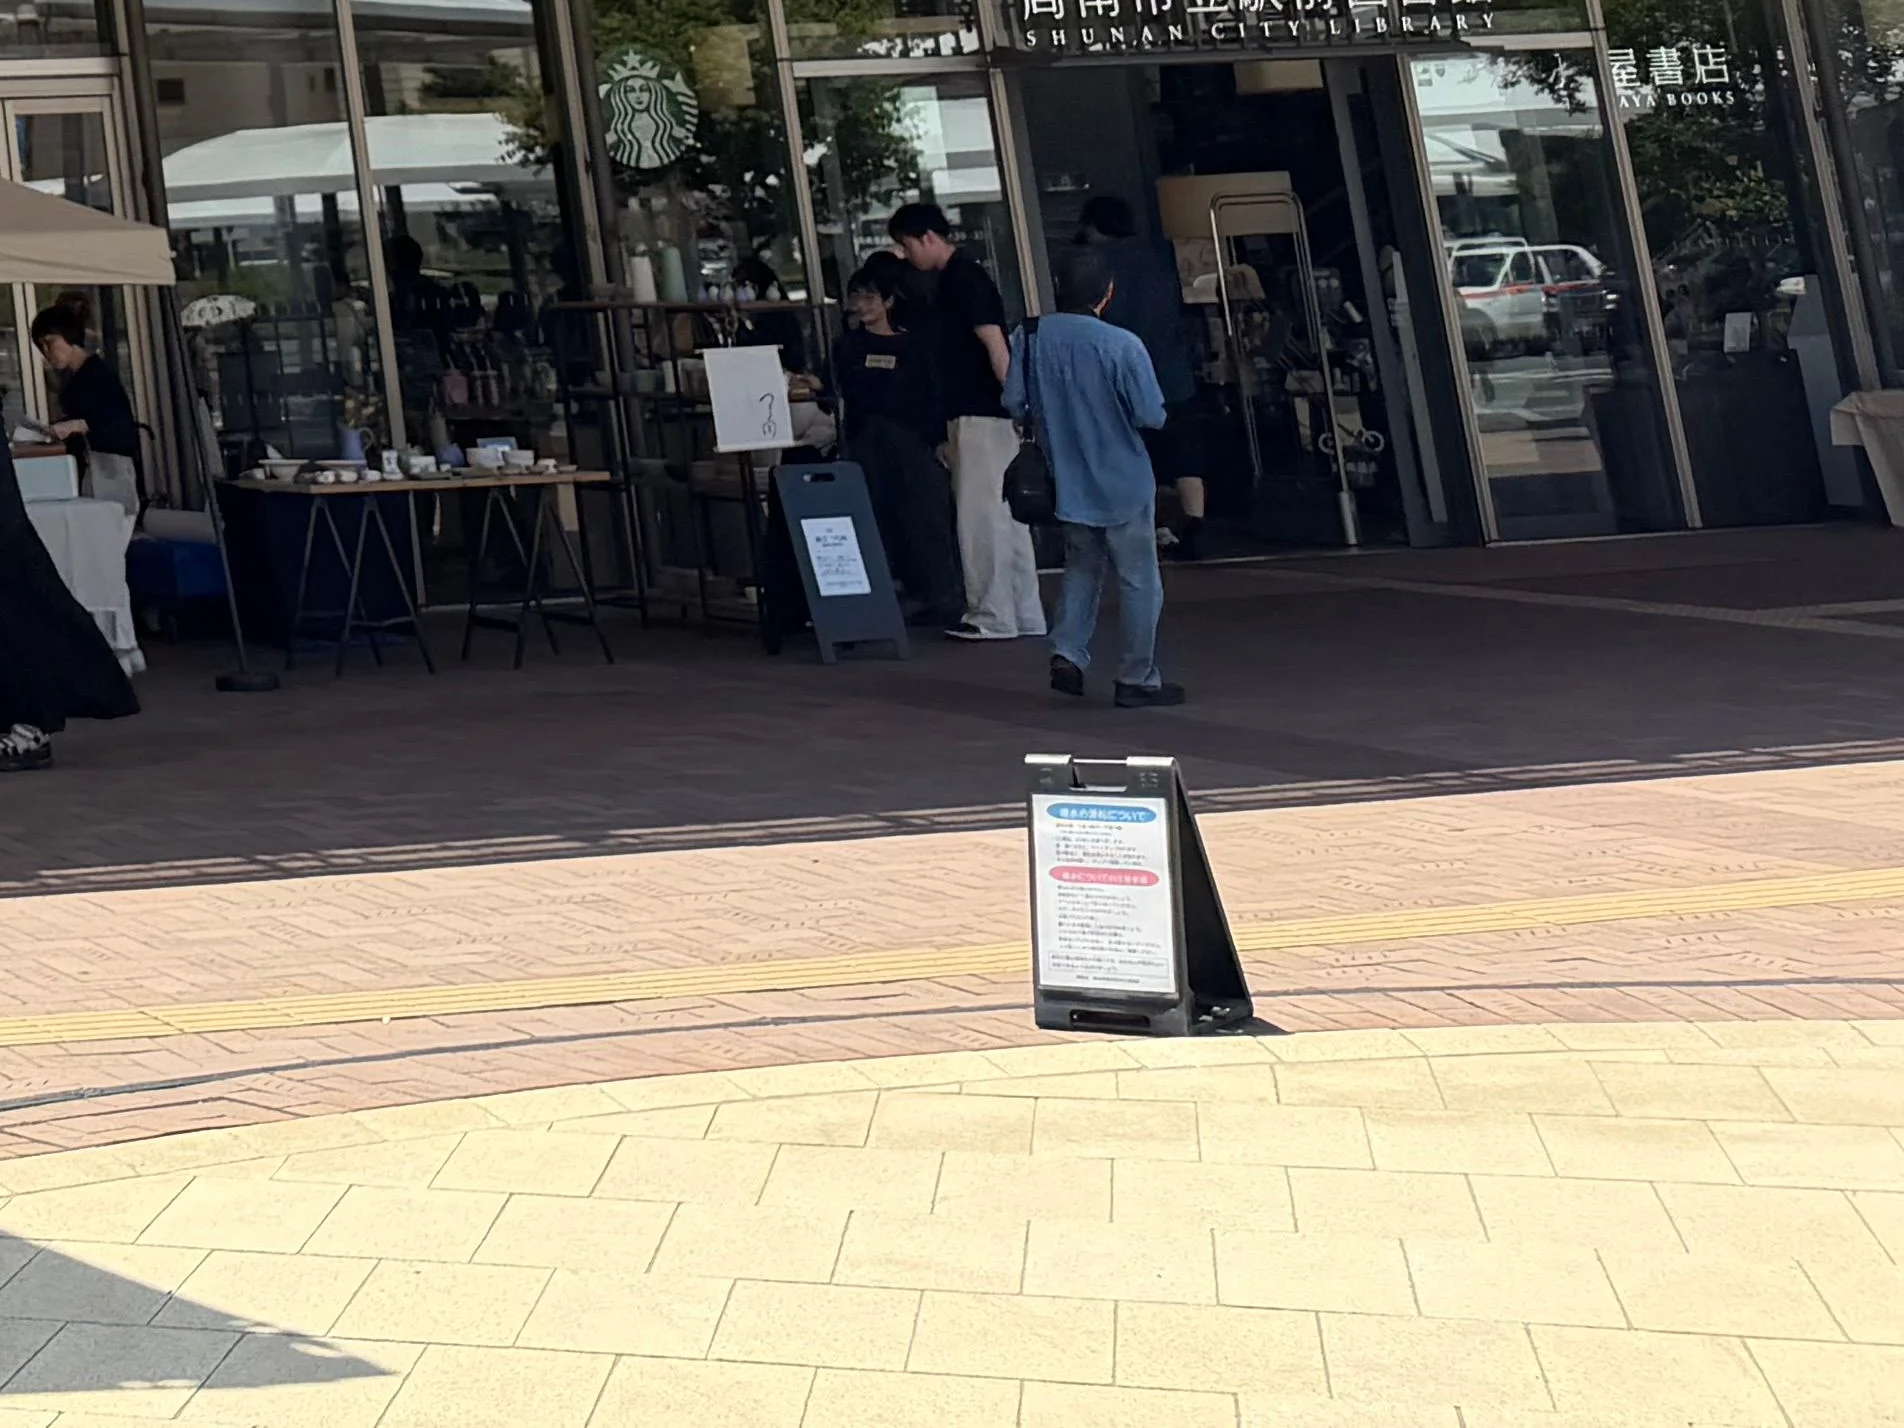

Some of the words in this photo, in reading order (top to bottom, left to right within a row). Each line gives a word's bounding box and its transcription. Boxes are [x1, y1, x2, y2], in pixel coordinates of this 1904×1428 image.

[1027, 24, 1183, 46] SHUNAN
[1211, 19, 1299, 39] CITY
[1329, 13, 1494, 35] LIBRARY
[1667, 91, 1734, 107] BOOKS
